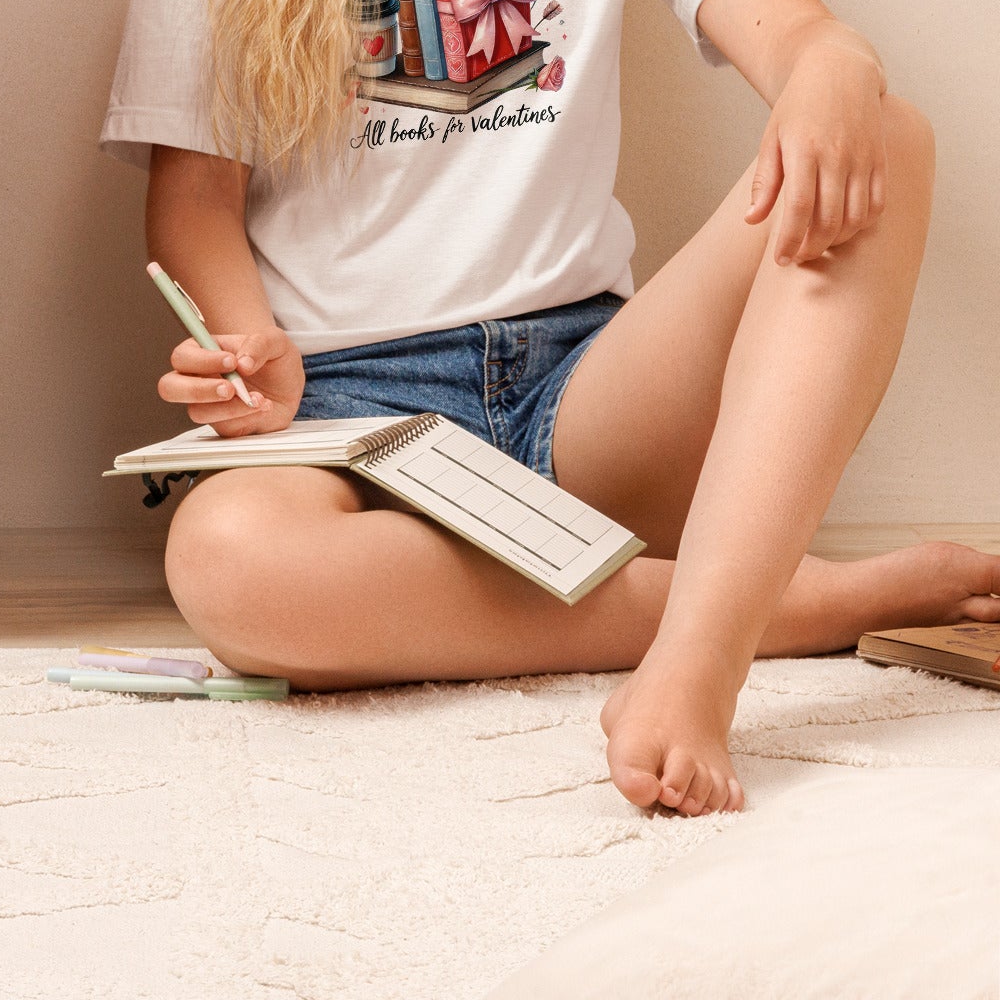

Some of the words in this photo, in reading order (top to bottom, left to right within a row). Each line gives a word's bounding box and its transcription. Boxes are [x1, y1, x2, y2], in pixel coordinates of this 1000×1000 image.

[350, 119, 386, 149] All
[390, 115, 440, 143] books
[442, 117, 465, 143] for
